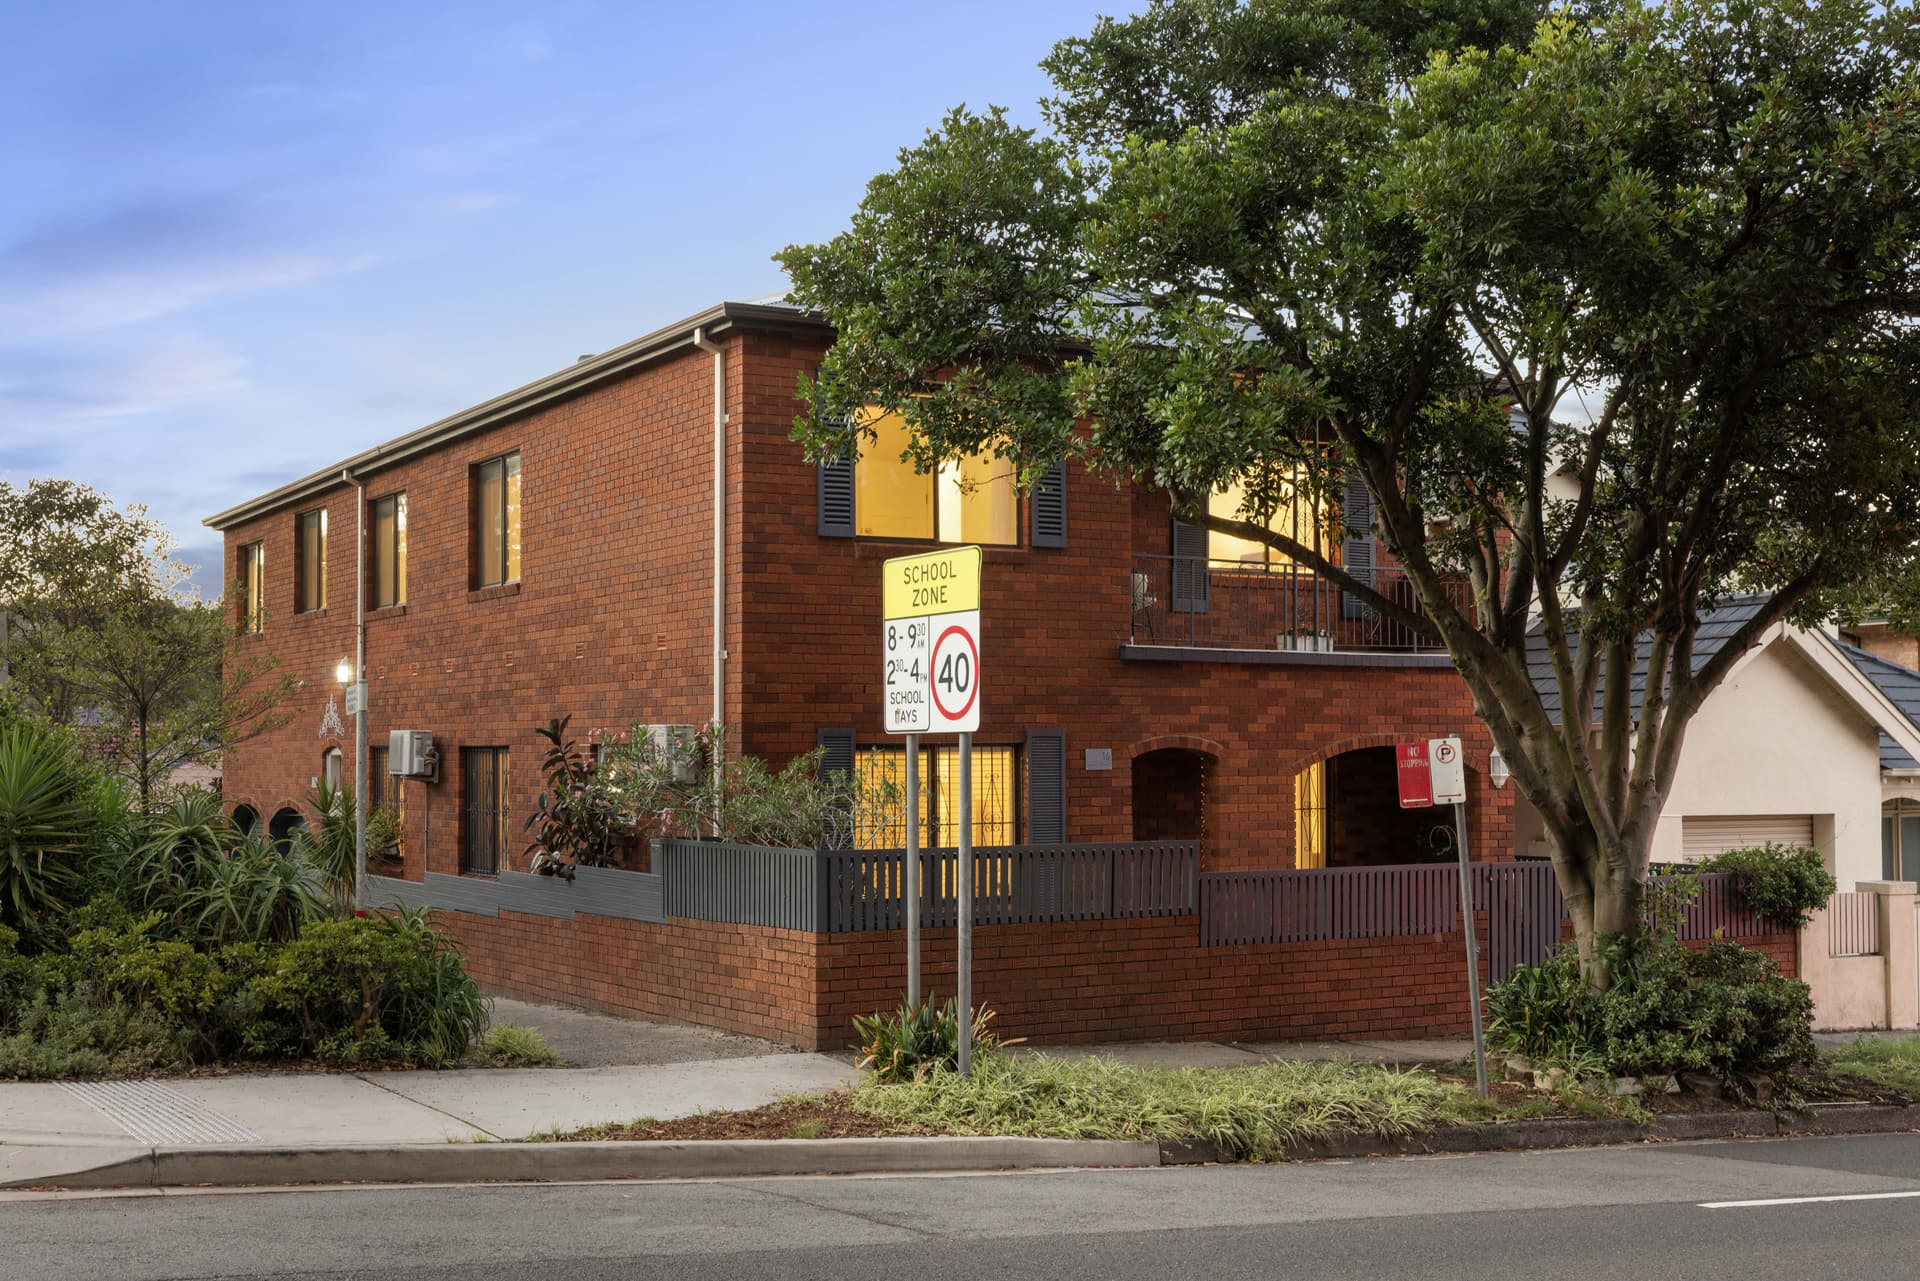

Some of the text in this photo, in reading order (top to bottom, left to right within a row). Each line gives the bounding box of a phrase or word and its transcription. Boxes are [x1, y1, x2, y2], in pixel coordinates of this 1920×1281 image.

[904, 560, 957, 585] SCHOOL
[912, 585, 948, 607] ZONE
[938, 652, 970, 693] 40
[890, 690, 925, 705] SCHOOL
